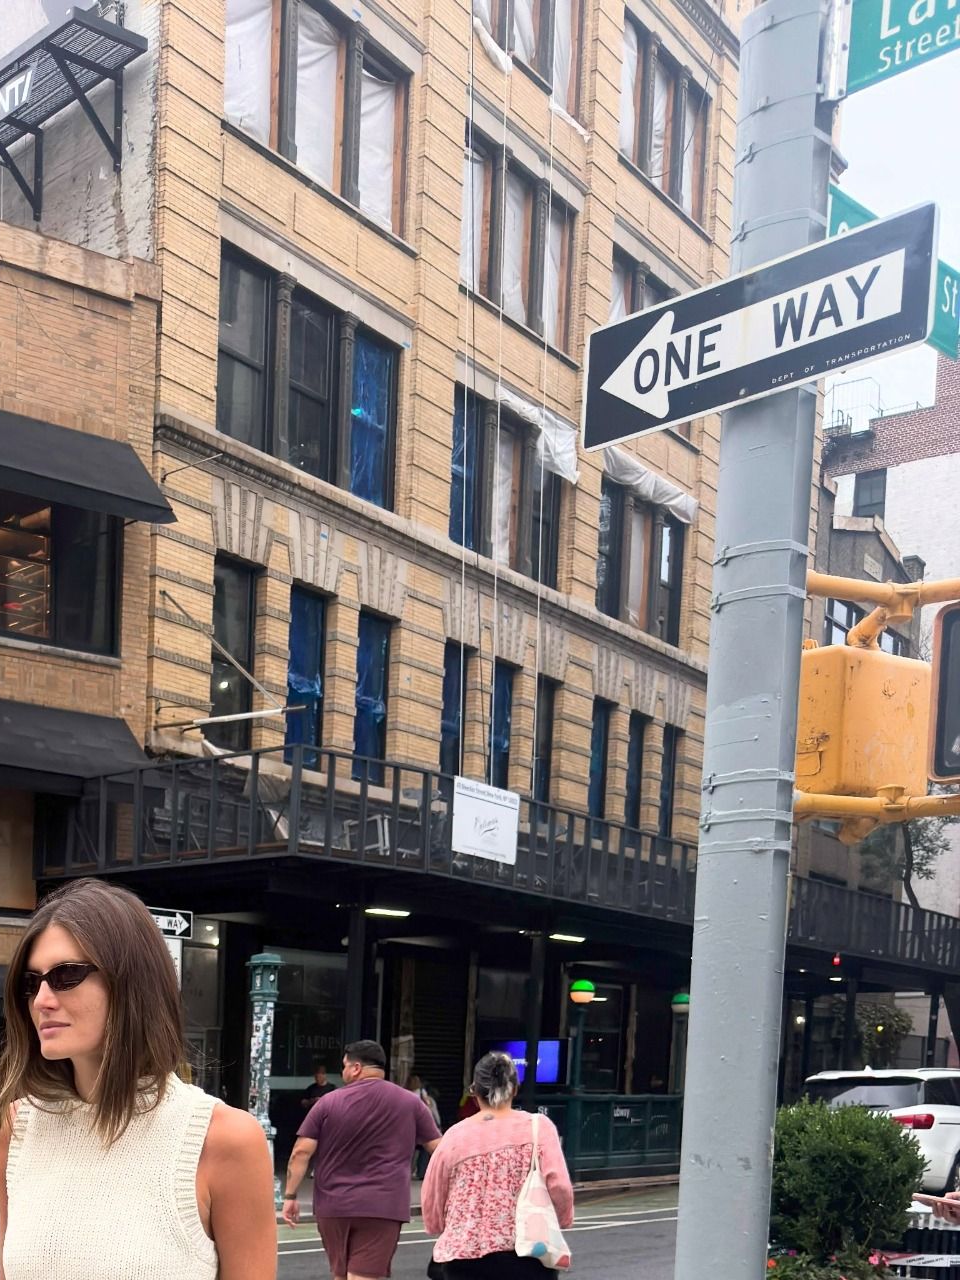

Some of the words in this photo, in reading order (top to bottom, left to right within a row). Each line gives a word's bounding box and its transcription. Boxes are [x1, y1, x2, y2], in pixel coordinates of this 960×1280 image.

[941, 275, 959, 318] St
[633, 323, 722, 395] ONE
[772, 264, 882, 349] WAY
[771, 372, 795, 385] DEPT
[804, 365, 816, 374] OF
[825, 333, 911, 368] TRANSPORTATION
[166, 918, 184, 929] WAY
